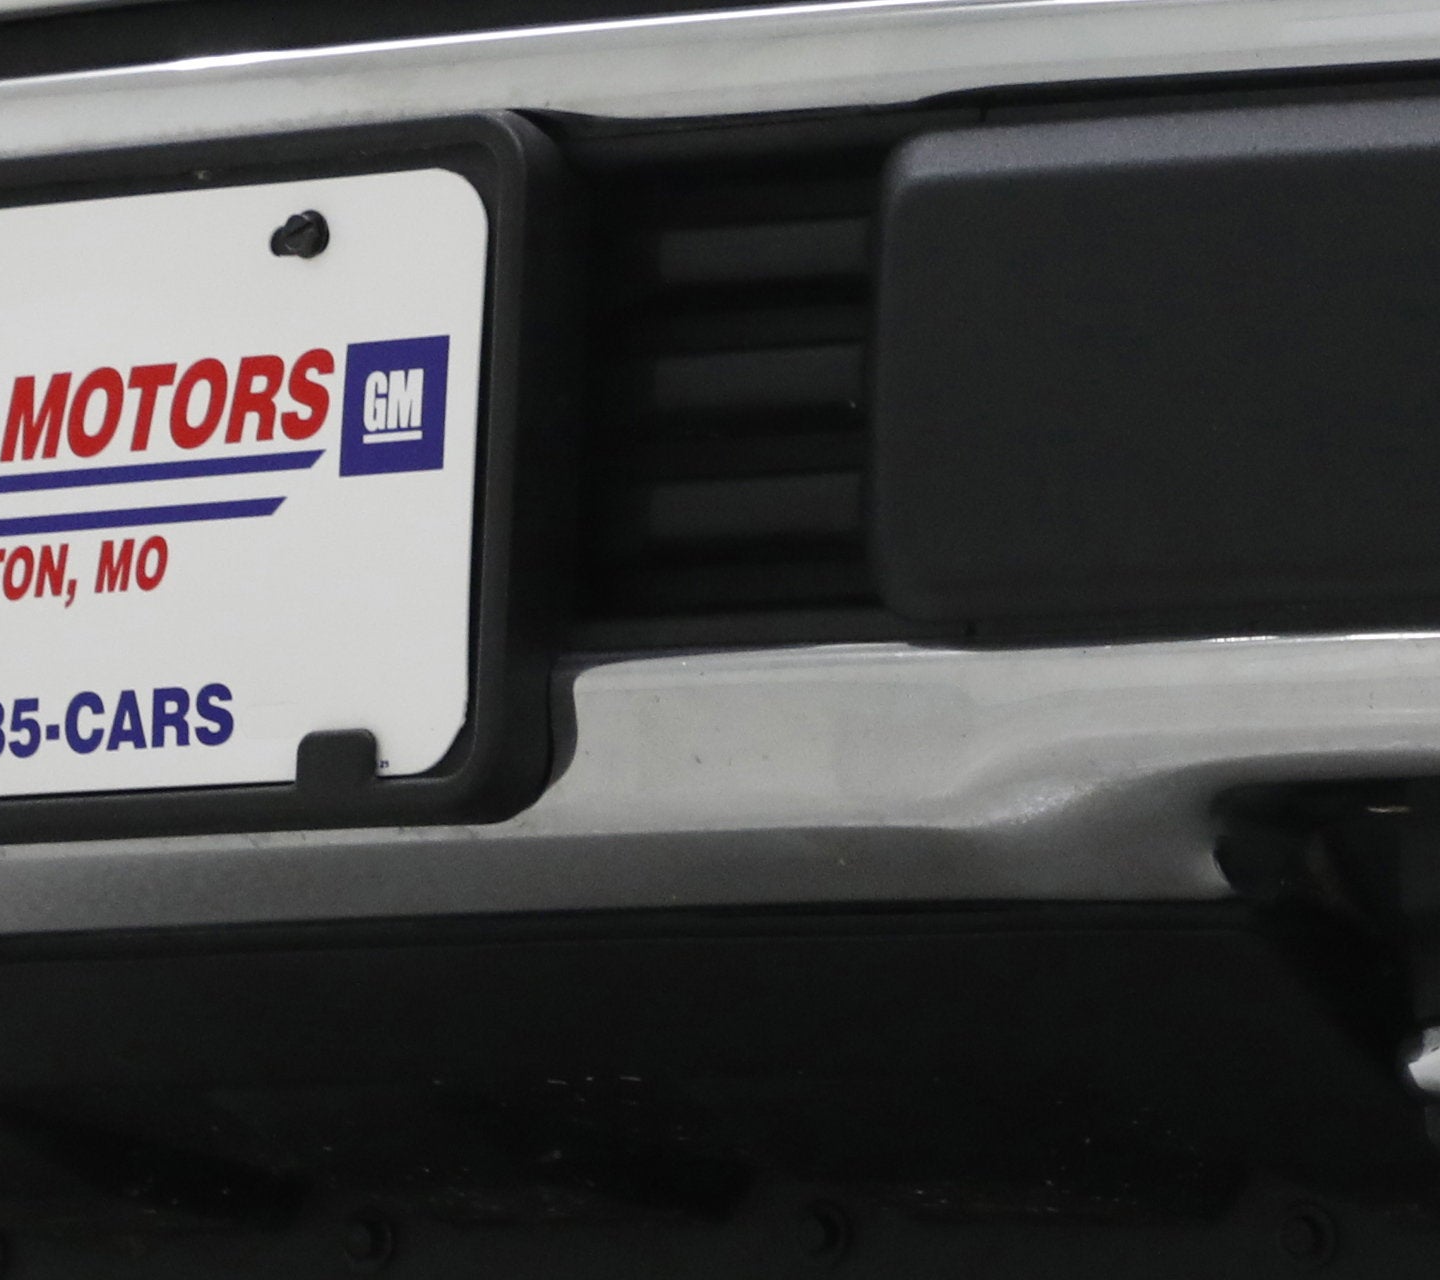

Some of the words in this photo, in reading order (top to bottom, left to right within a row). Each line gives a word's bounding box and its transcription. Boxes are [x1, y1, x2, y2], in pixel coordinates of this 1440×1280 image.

[0, 347, 336, 463] MOTORS
[363, 368, 424, 431] GM
[95, 535, 169, 593] MO
